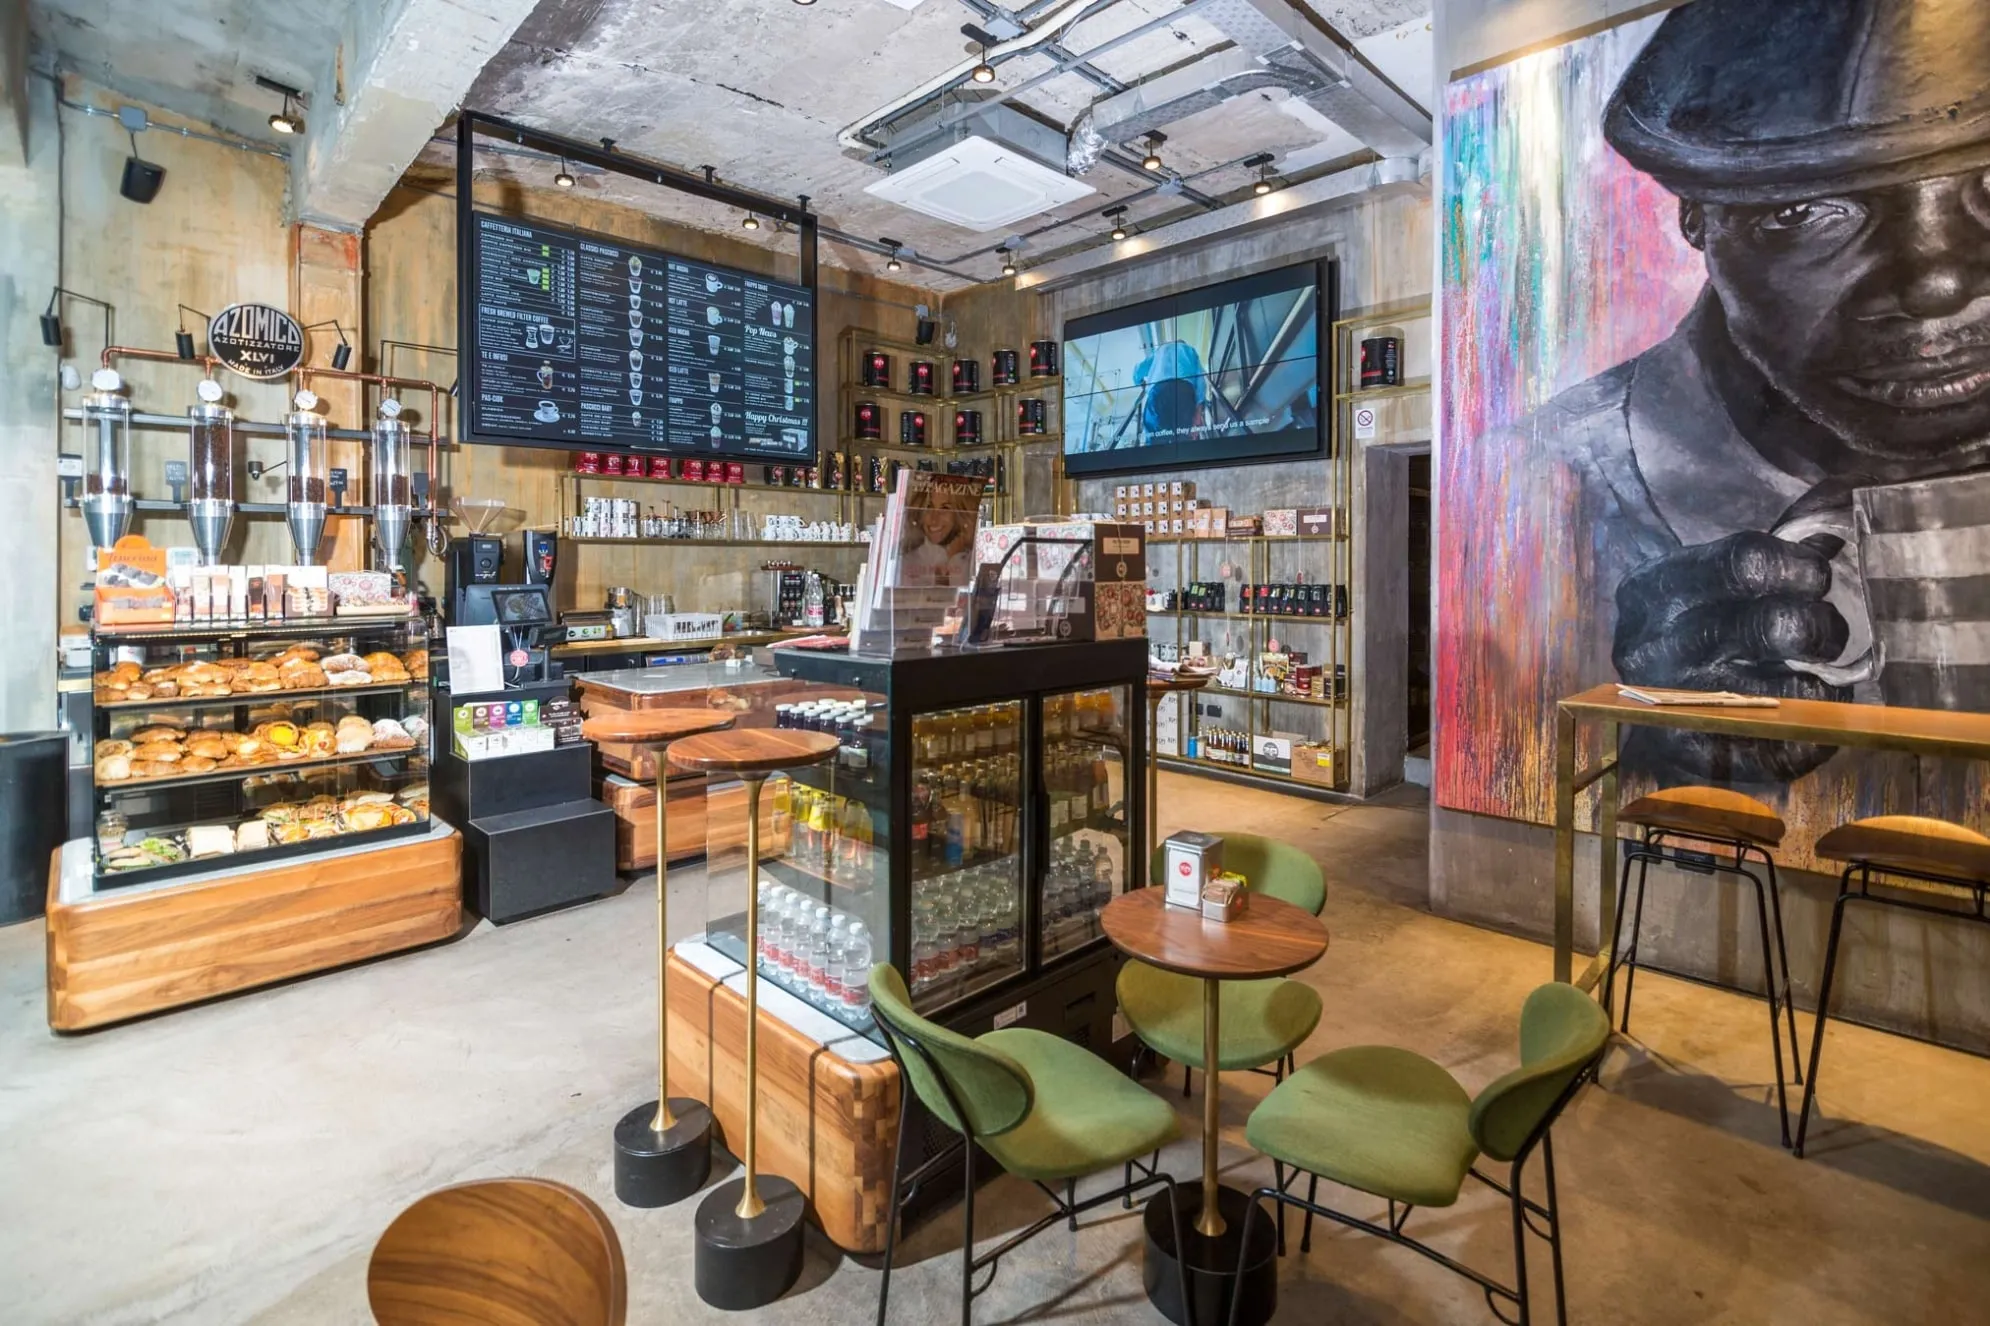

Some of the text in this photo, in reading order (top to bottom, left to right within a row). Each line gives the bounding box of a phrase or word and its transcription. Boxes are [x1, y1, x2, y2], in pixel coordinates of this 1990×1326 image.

[481, 220, 533, 239] CAFFETTERIA ITALIANA
[481, 306, 496, 315] FRESH
[516, 312, 532, 321] FILTER
[532, 315, 549, 324] COFFEE
[213, 305, 301, 345] AZOMICO
[744, 324, 777, 338] Pop News
[213, 336, 300, 353] AZOTIZZATORE
[240, 349, 275, 364] XLVI
[227, 358, 251, 374] MADE
[264, 363, 284, 375] ITALY
[744, 411, 767, 424] Happy
[768, 414, 801, 425] Christmas
[1155, 428, 1175, 437] coffee,
[1176, 426, 1190, 436] they
[1190, 424, 1212, 434] always
[1245, 418, 1270, 427] sample
